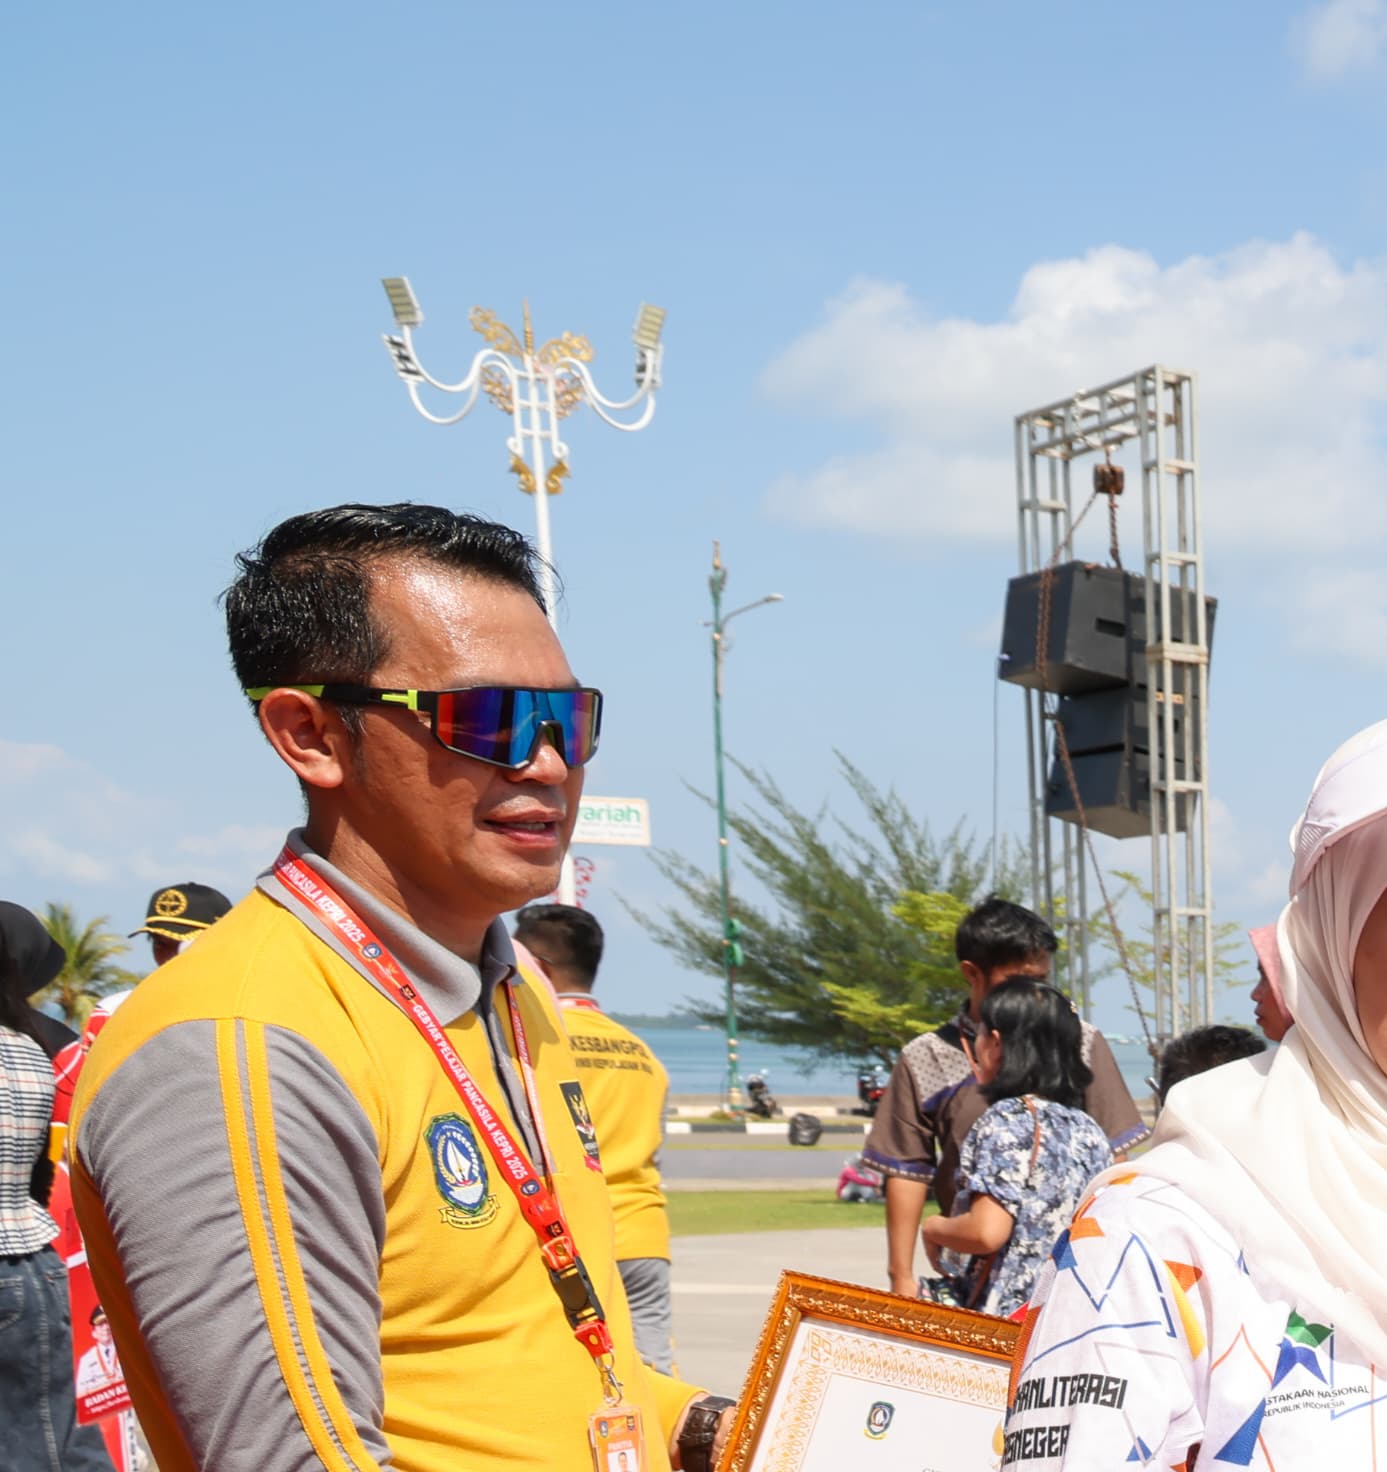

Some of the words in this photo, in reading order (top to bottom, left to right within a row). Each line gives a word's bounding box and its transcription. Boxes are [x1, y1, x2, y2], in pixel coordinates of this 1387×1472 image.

[316, 894, 347, 925] KEPRI
[337, 919, 366, 943] 2025
[412, 1003, 443, 1042] GEBYAR
[436, 1038, 467, 1081] PELAJAR
[461, 1076, 498, 1131] PANCASILA
[490, 1127, 515, 1158] KEPRI
[506, 1152, 529, 1180] 2025
[1266, 1388, 1315, 1405] STAKAAN
[1317, 1385, 1370, 1399] NASIONAL
